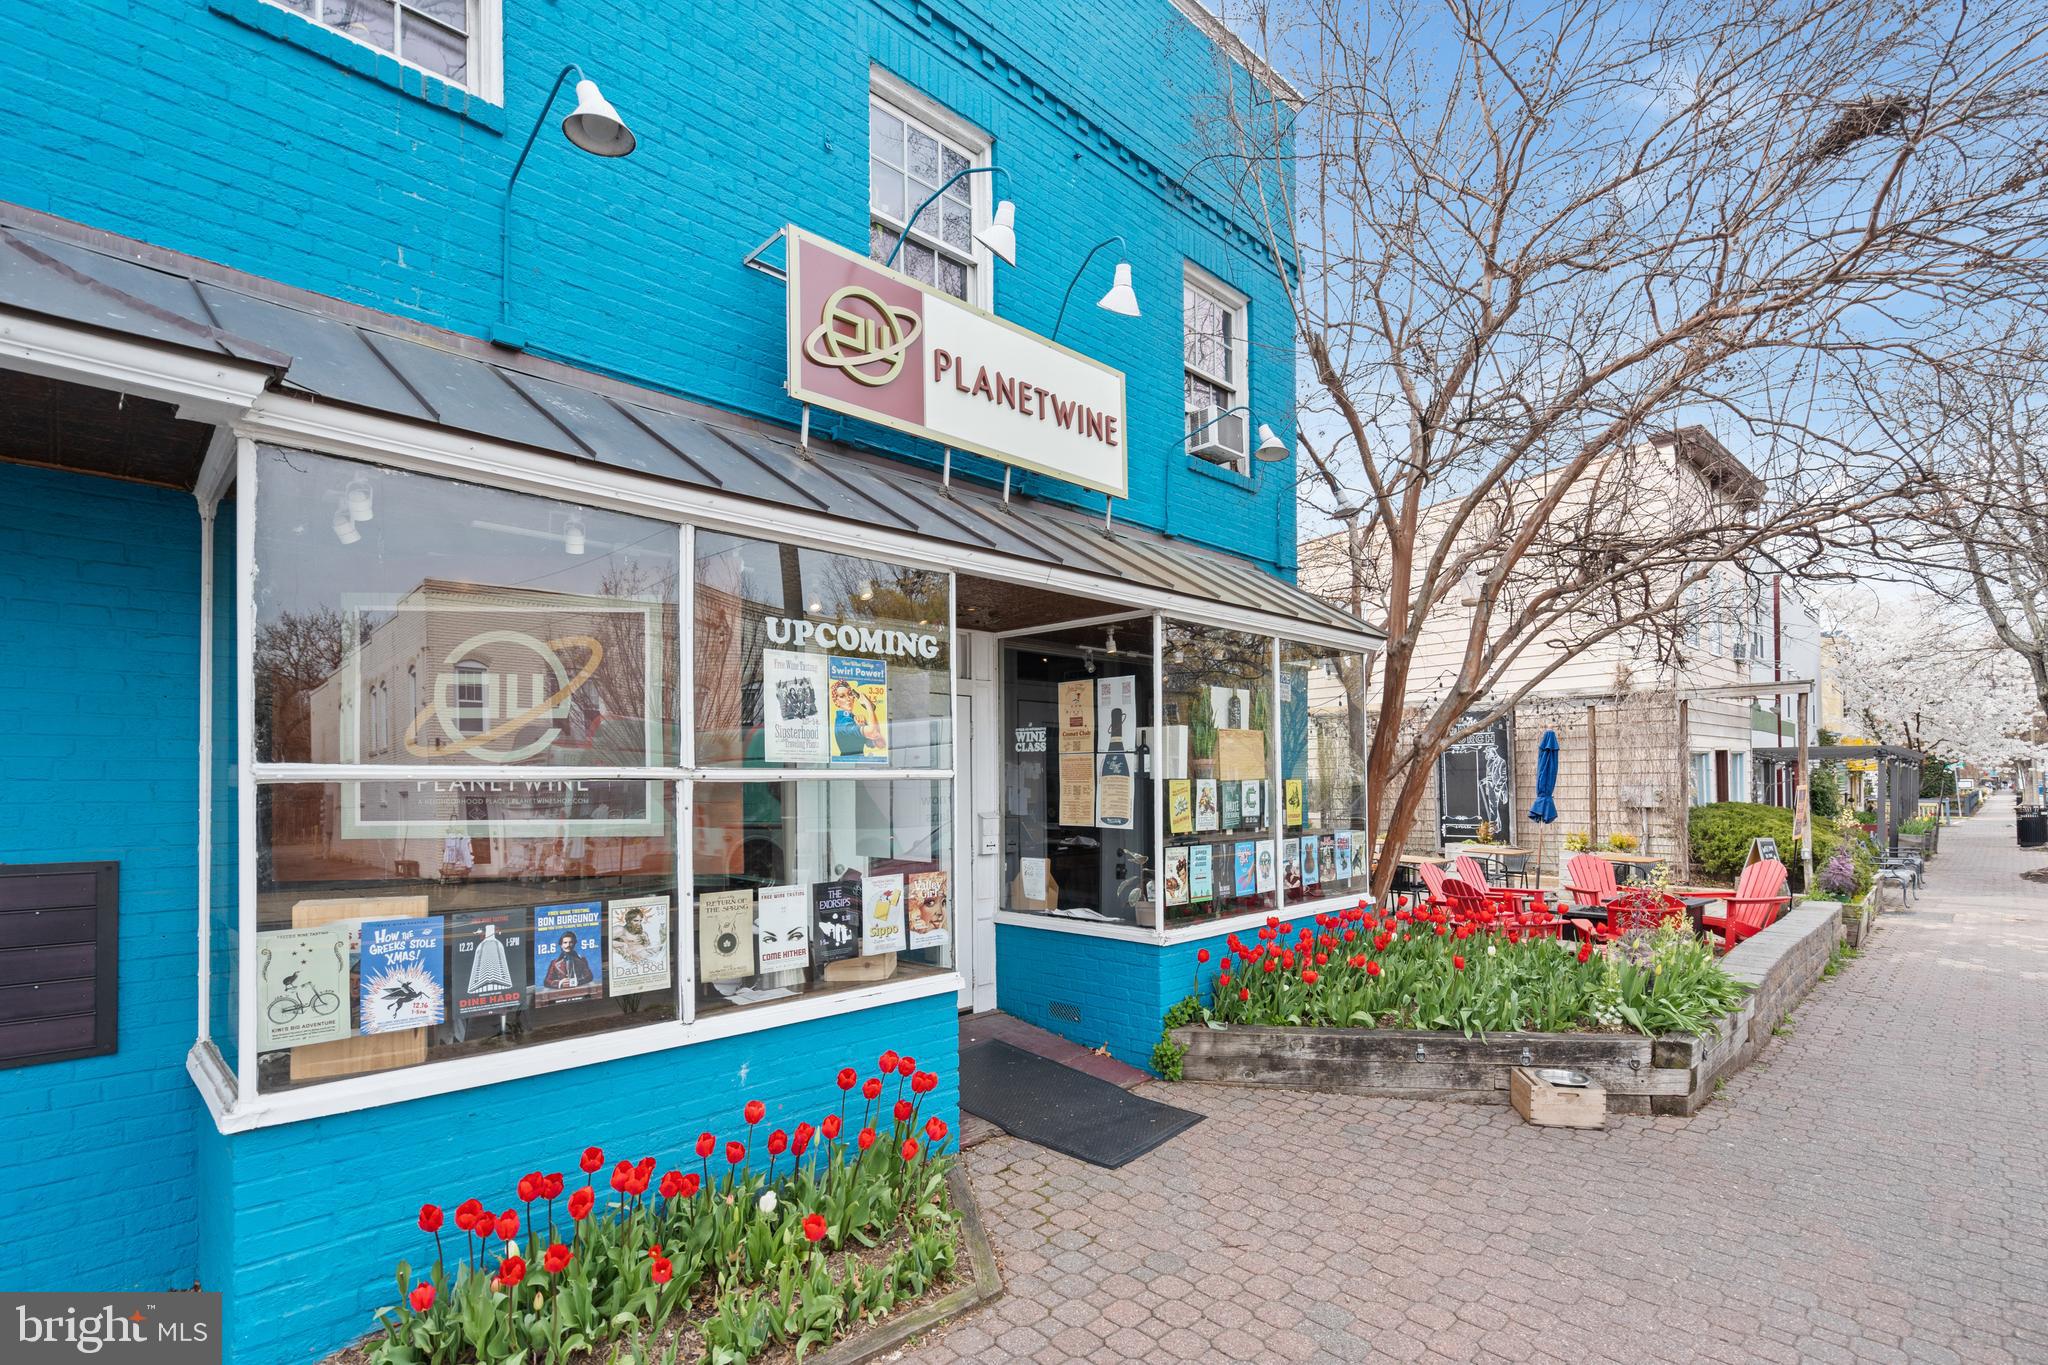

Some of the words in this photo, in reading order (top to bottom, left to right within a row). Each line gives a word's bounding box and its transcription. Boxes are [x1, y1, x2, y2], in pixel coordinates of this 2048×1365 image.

[933, 348, 1118, 447] PLANETWINE
[764, 616, 940, 659] UPCOMING
[831, 665, 852, 676] Swirl
[855, 666, 885, 678] Power!
[1015, 731, 1047, 742] WINE
[1015, 742, 1047, 752] CLASS
[828, 889, 842, 899] THE
[706, 899, 736, 908] RETURN
[721, 904, 749, 912] SPRING
[819, 898, 850, 910] EXORSIPS
[537, 916, 555, 927] BON
[556, 912, 599, 925] BURGUNDY
[402, 930, 414, 940] THE
[369, 940, 406, 955] GREEKS
[410, 938, 437, 949] STOLE
[459, 942, 474, 952] 12.23
[537, 943, 557, 955] 12.6
[384, 950, 421, 965] XMAS!
[762, 952, 782, 961] COME
[782, 948, 807, 959] HITHER
[615, 965, 639, 977] Dad
[642, 960, 665, 973] Bod
[459, 997, 487, 1007] DINE
[489, 992, 520, 1003] HARD
[301, 1020, 336, 1029] ADVENTURE
